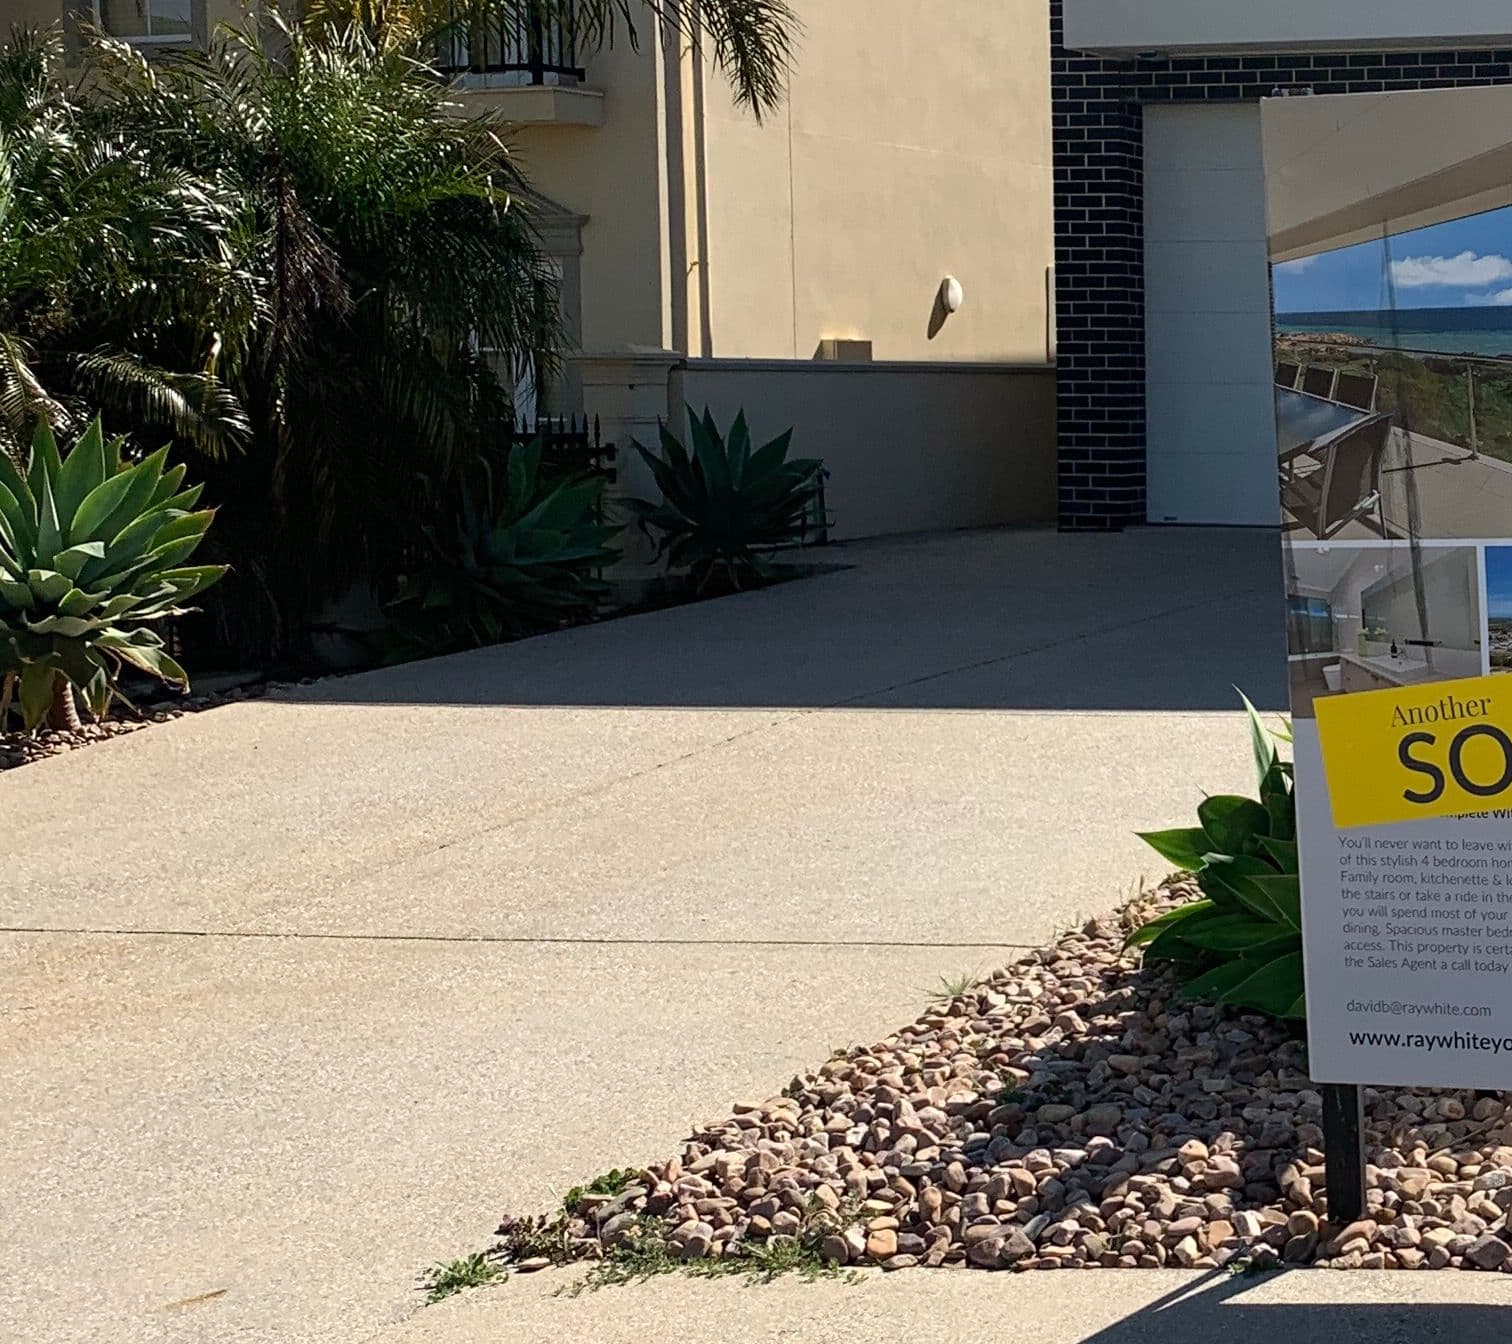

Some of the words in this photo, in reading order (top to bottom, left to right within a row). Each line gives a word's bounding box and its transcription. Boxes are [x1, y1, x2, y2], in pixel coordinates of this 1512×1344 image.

[1390, 695, 1491, 728] Another
[1338, 836, 1371, 849] You'll
[1375, 839, 1408, 849] never
[1413, 838, 1442, 850] want
[1446, 839, 1458, 850] to
[1462, 839, 1494, 851] leave
[1340, 855, 1352, 866] of
[1356, 855, 1377, 866] this
[1381, 855, 1418, 869] stylish
[1422, 856, 1429, 866] 4
[1434, 856, 1488, 868] bedroom
[1341, 871, 1379, 885] Family
[1383, 873, 1417, 885] room,
[1421, 872, 1488, 886] kitchenette
[1493, 874, 1502, 886] &
[1341, 889, 1361, 900] the
[1365, 889, 1395, 900] stairs
[1400, 892, 1411, 901] or
[1415, 890, 1440, 902] take
[1445, 893, 1451, 902] a
[1455, 891, 1478, 902] ride
[1482, 891, 1492, 903] in
[1343, 908, 1364, 918] you
[1368, 906, 1387, 917] will
[1392, 907, 1427, 920] spend
[1431, 908, 1460, 919] most
[1464, 908, 1477, 920] of
[1481, 910, 1507, 921] your
[1343, 923, 1380, 936] dining.
[1386, 923, 1438, 936] Spacious
[1442, 926, 1483, 936] master
[1344, 941, 1384, 951] access.
[1390, 939, 1413, 952] This
[1418, 942, 1469, 955] property
[1473, 942, 1482, 954] is
[1345, 957, 1363, 968] the
[1368, 957, 1398, 968] Sales
[1401, 958, 1437, 971] Agent
[1441, 961, 1447, 969] a
[1451, 958, 1471, 970] call
[1475, 960, 1507, 974] today
[1346, 999, 1492, 1017] davidb@raywhite.com
